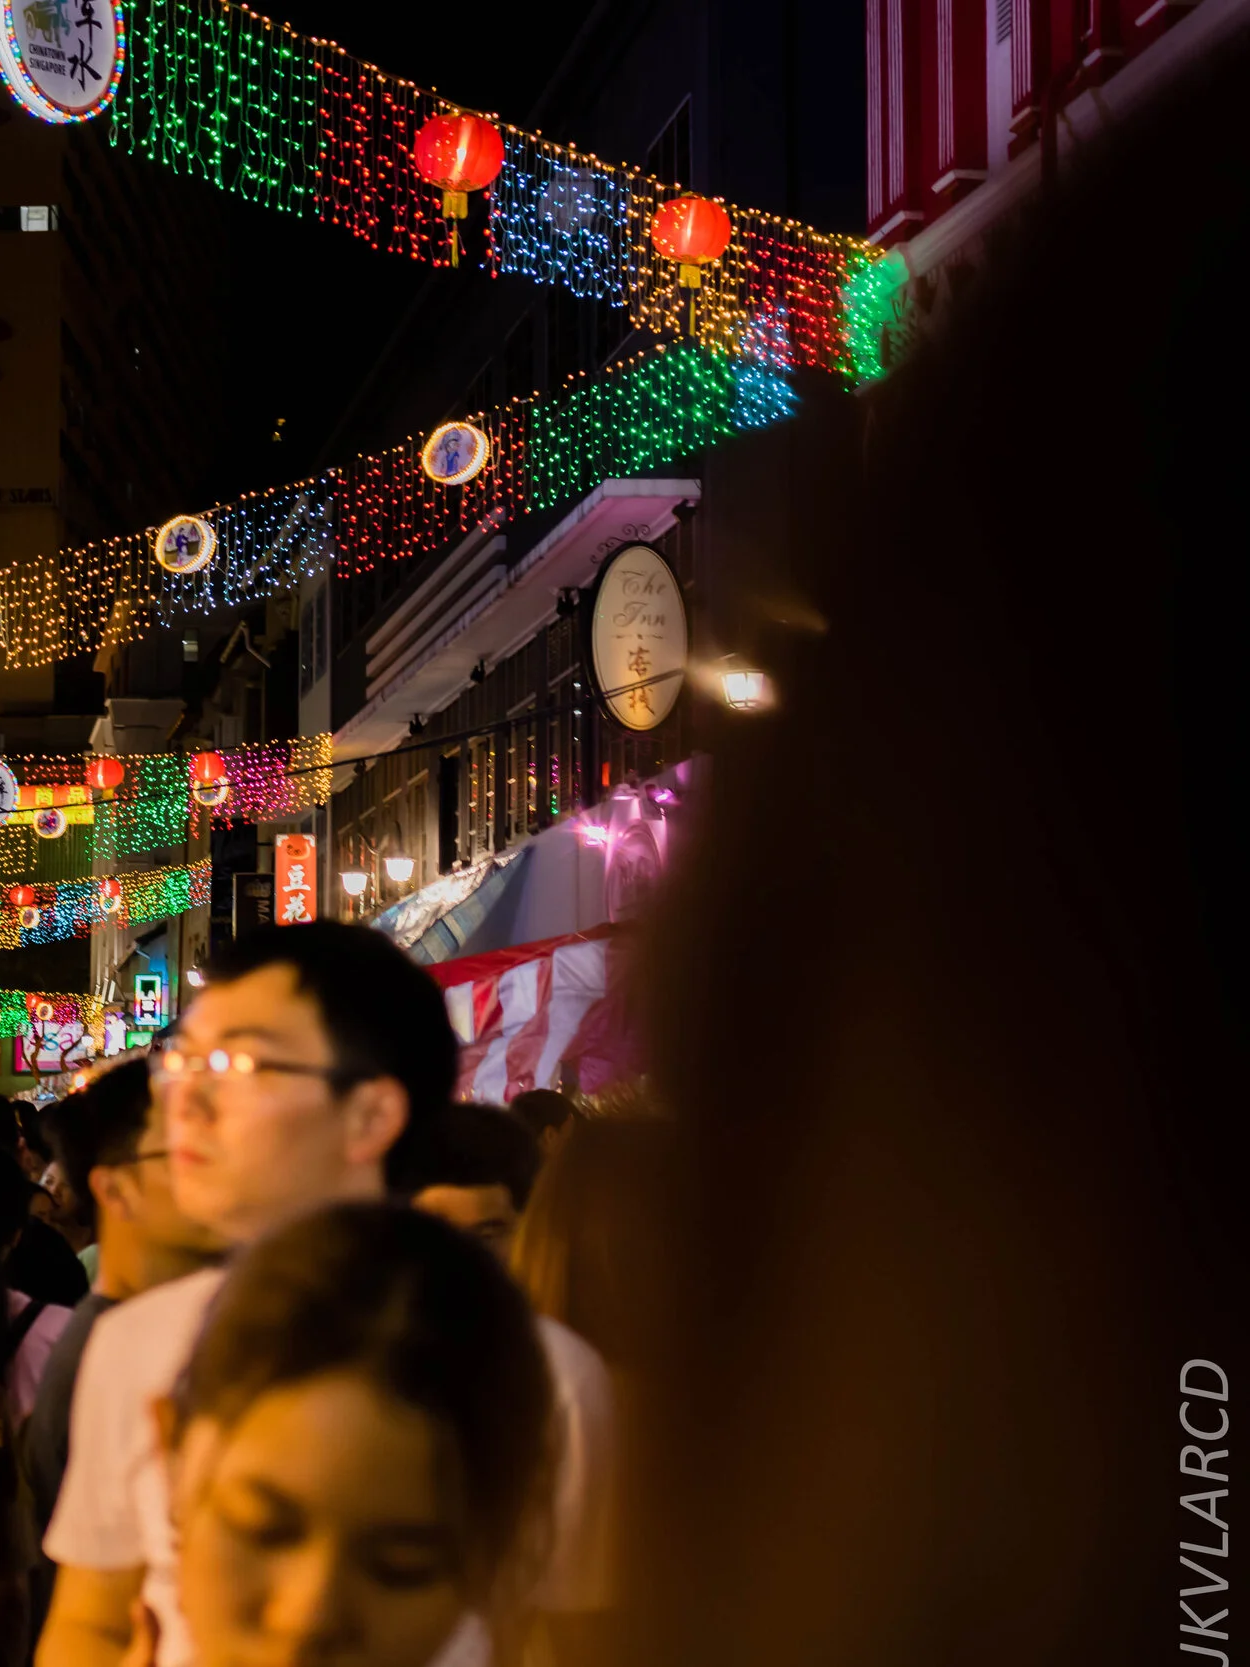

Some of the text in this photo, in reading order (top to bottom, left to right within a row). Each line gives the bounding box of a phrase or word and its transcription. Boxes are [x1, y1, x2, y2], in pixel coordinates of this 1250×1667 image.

[29, 43, 67, 61] CHINATOWN
[29, 58, 67, 77] SINGAPORE
[614, 569, 668, 597] The
[612, 601, 667, 628] Inn
[282, 864, 312, 922] 豆花
